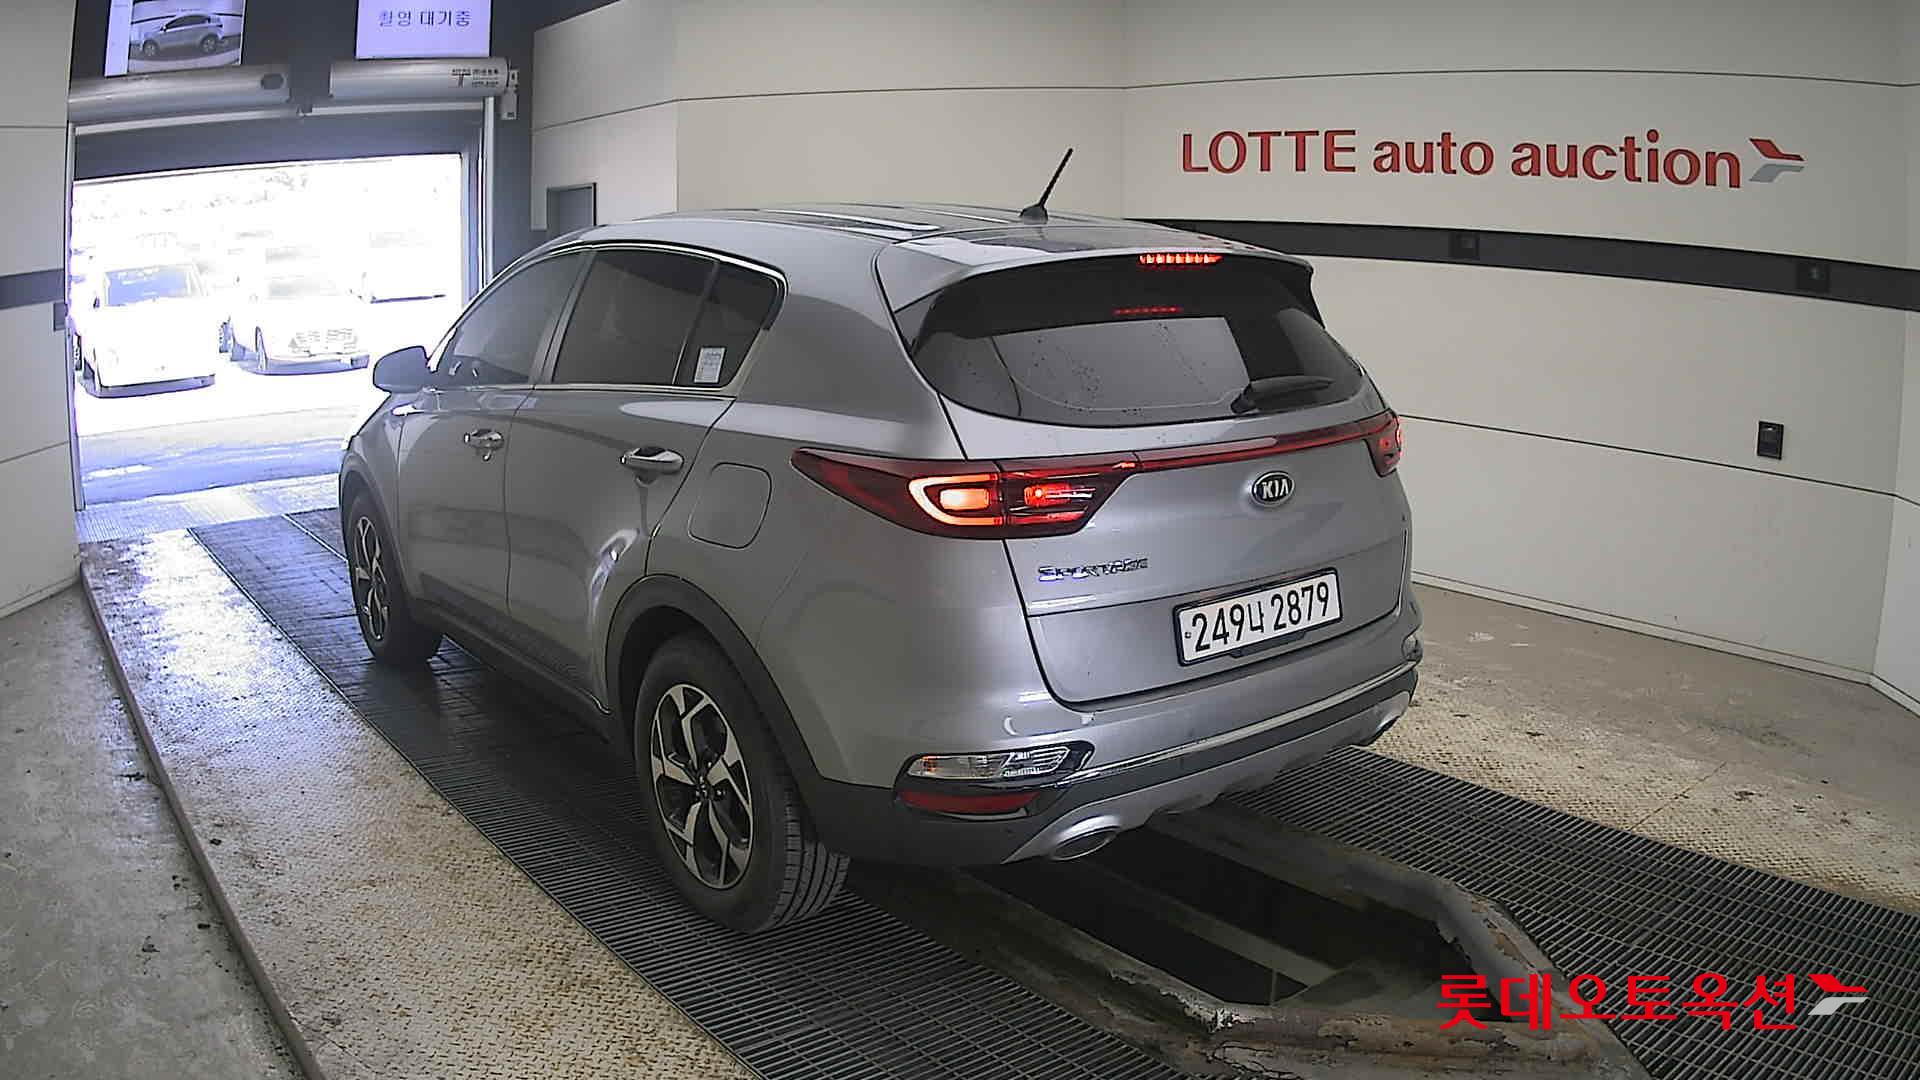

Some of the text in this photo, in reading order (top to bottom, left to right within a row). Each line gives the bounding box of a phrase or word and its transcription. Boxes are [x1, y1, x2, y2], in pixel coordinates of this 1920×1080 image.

[419, 10, 472, 27] 대기중
[1182, 128, 1742, 188] LOTTE auto auction
[1191, 581, 1330, 652] 249나 2879
